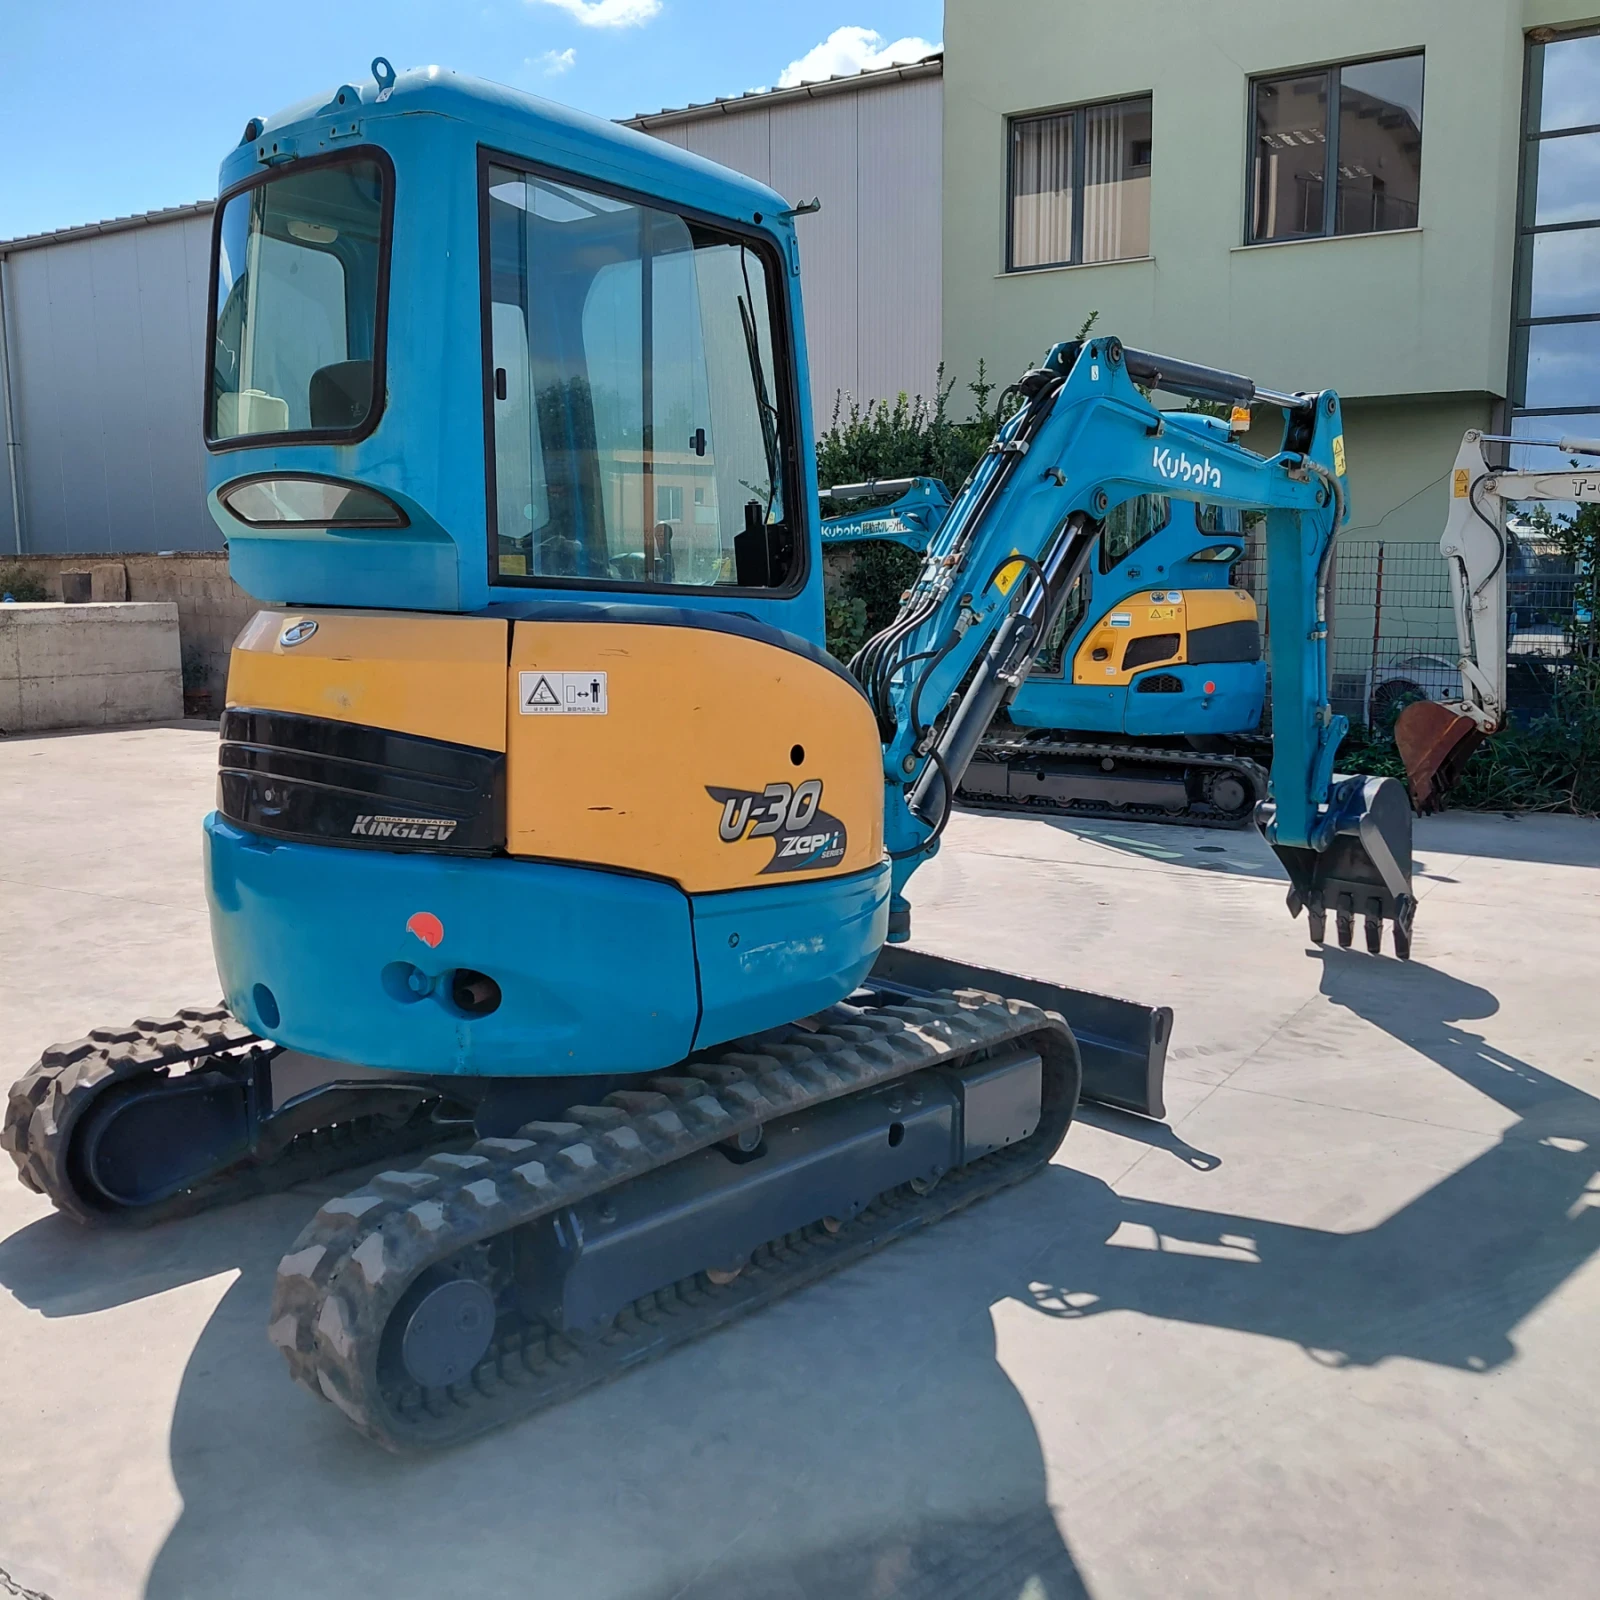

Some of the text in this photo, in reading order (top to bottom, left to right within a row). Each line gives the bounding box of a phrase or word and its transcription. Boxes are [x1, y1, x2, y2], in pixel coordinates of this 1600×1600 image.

[1153, 446, 1221, 489] Kubota
[1572, 479, 1600, 497] T-
[820, 523, 861, 537] Kubota
[719, 779, 823, 841] U-30
[821, 848, 844, 859] SERIES
